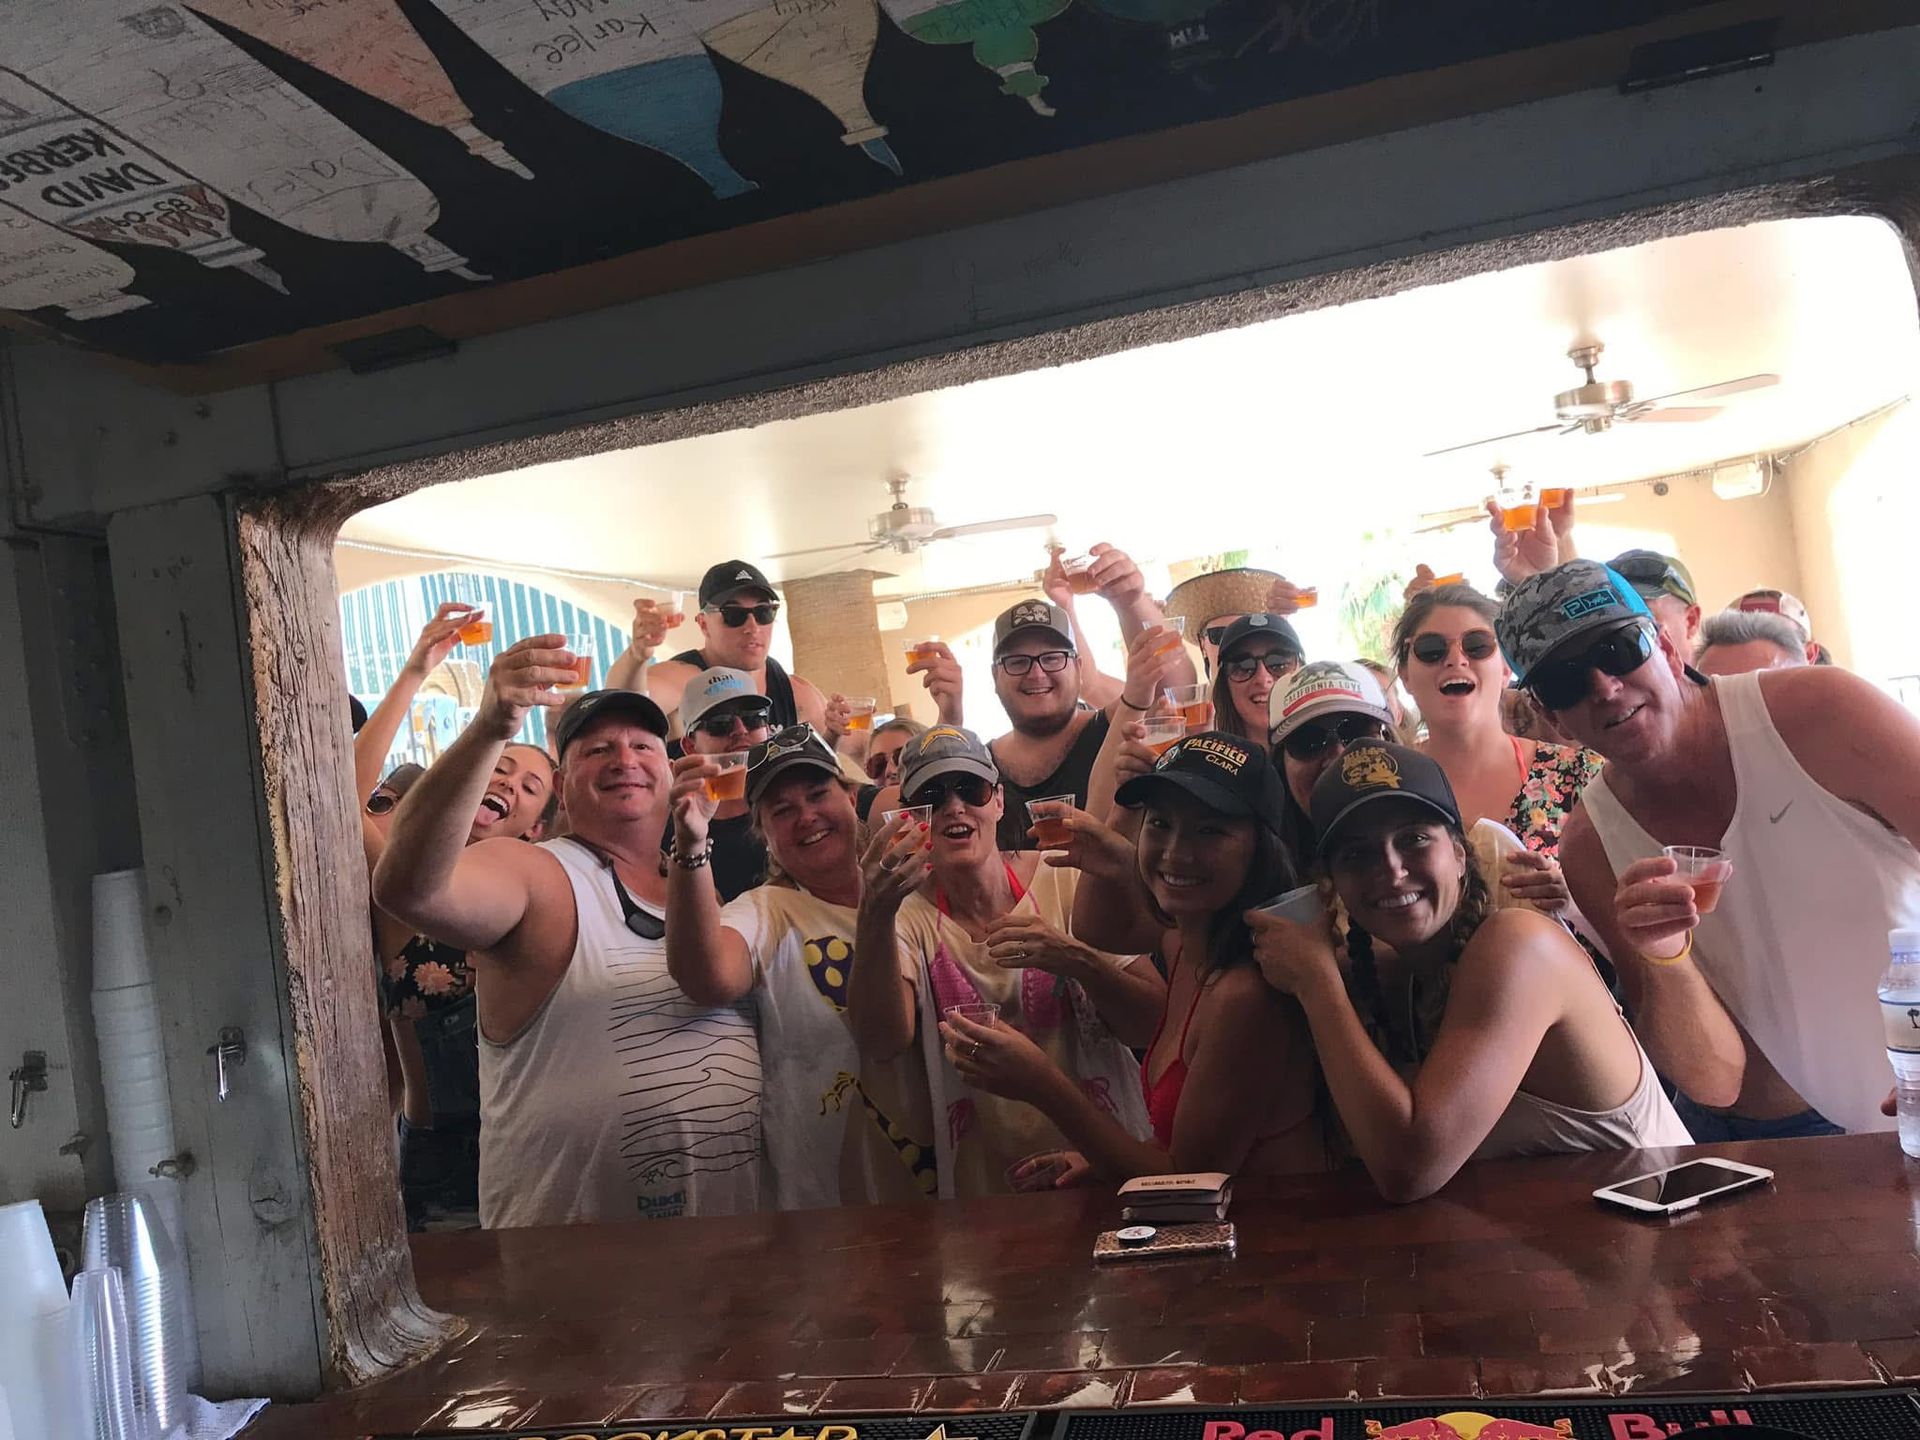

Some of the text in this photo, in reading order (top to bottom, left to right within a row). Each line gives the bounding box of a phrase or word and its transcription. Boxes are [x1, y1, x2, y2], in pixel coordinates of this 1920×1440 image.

[40, 162, 167, 209] DAVID
[1283, 680, 1335, 706] CALIFORNIA
[1182, 736, 1249, 766] PACIFICO
[1204, 753, 1239, 776] CLARA
[1202, 1409, 1753, 1440] Red Bll
